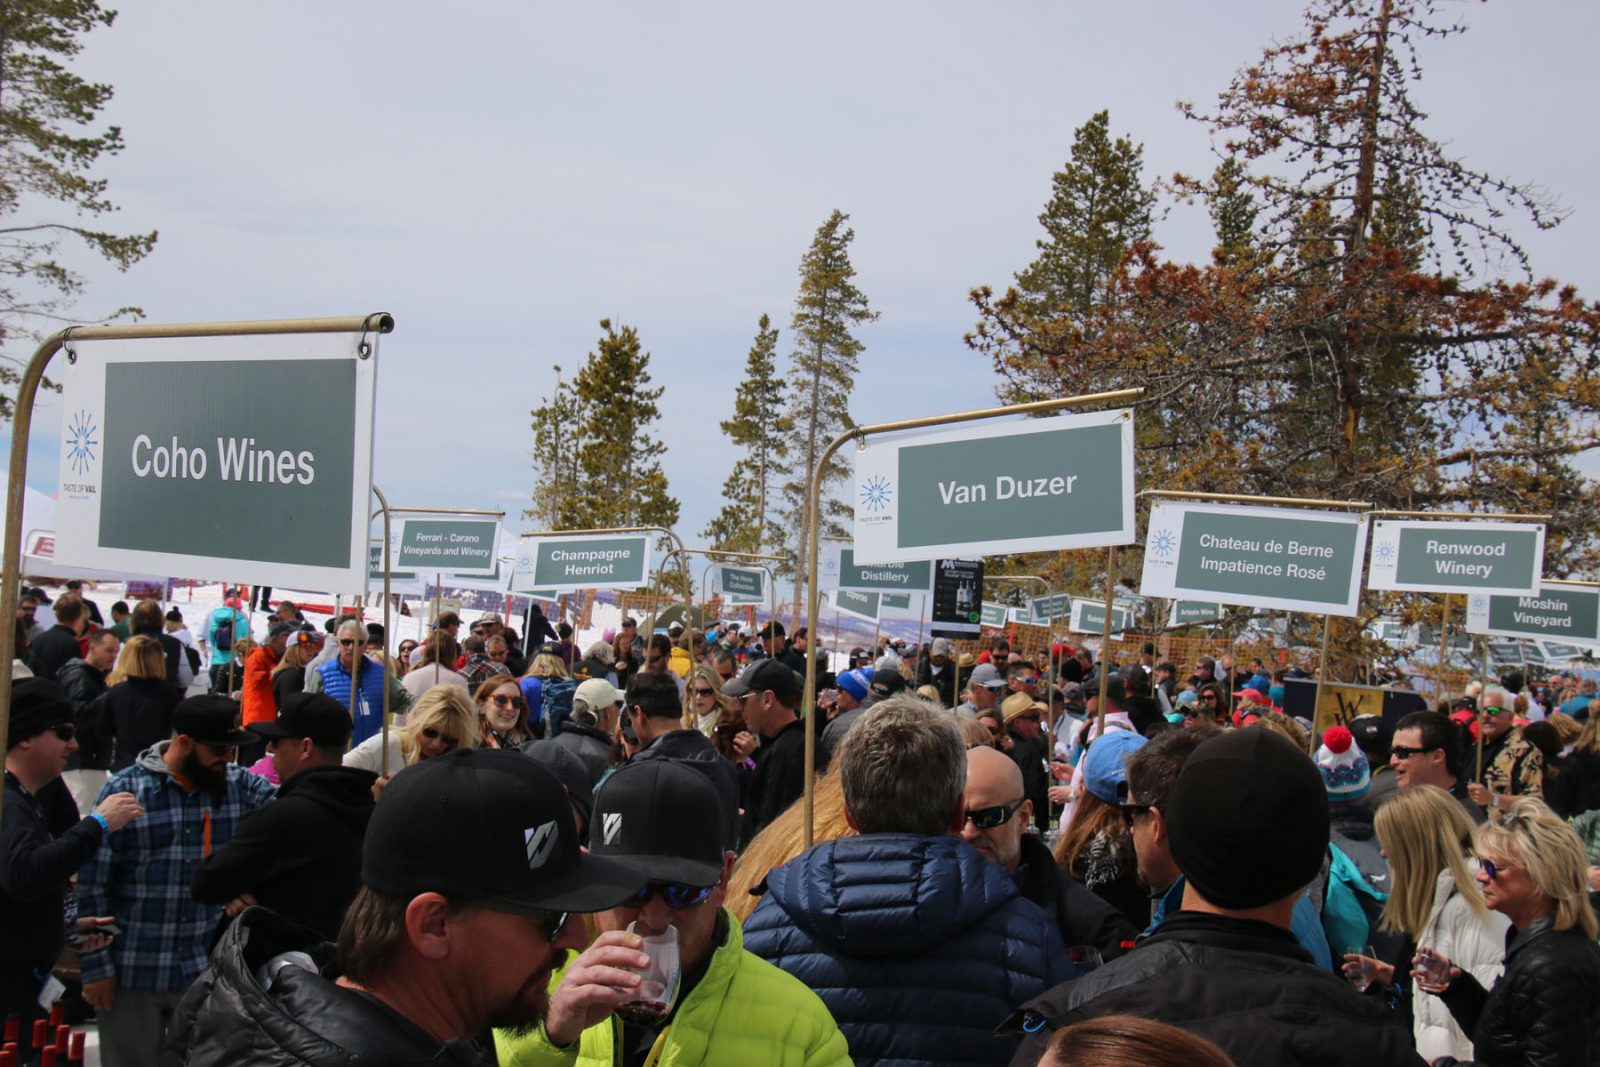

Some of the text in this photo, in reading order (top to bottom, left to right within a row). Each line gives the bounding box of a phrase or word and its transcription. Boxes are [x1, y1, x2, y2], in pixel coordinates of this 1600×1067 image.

[132, 434, 315, 485] Coho Wines
[63, 484, 96, 494] TASTE OF VAIL
[938, 474, 1078, 505] Van Duzer
[416, 532, 443, 542] Ferrari
[450, 533, 480, 543] Carano
[1199, 533, 1334, 558] Chateau de Berne
[403, 545, 490, 558] Vineyards and Winery
[551, 548, 630, 563] Champagne
[1426, 540, 1506, 558] Renwood
[565, 564, 614, 576] Henriot
[861, 570, 909, 584] Distillery
[1201, 556, 1326, 581] Impatience Rosé
[1435, 560, 1493, 579] Winery
[1519, 596, 1568, 612] Moshin
[1513, 609, 1572, 628] Vineyard
